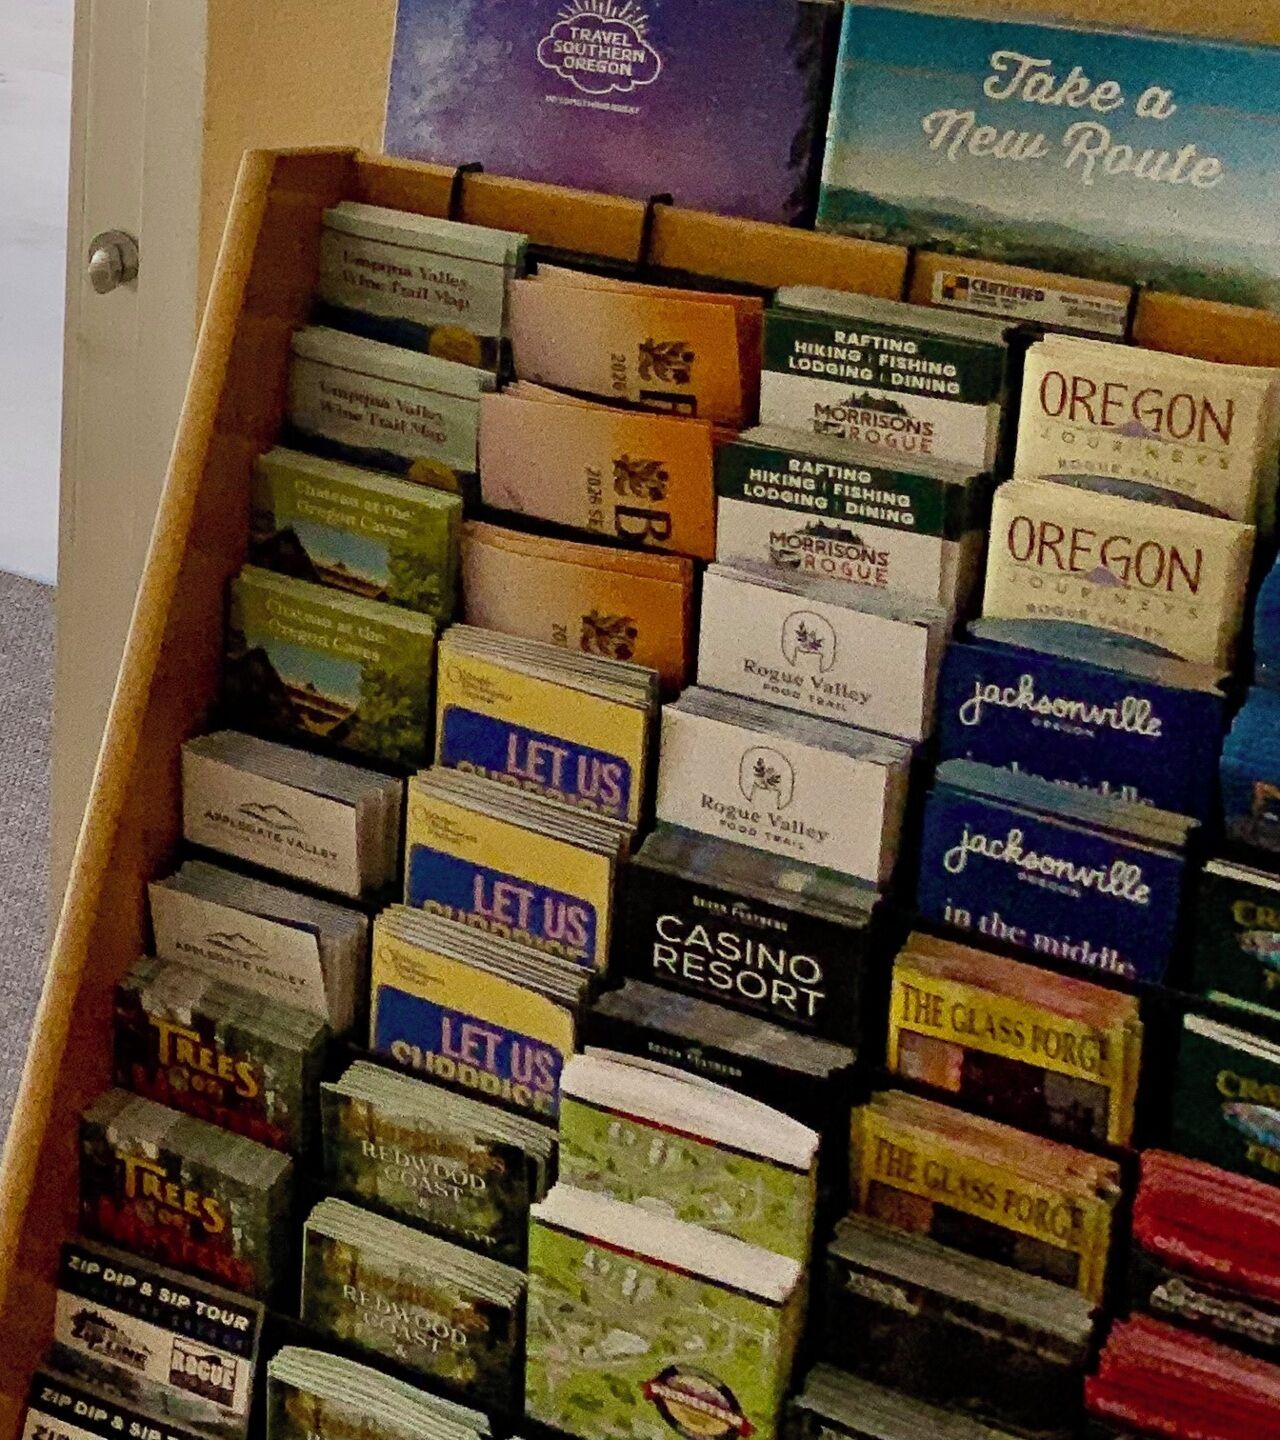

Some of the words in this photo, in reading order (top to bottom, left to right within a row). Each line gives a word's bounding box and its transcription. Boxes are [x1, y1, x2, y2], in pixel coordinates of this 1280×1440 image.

[553, 40, 647, 64] SOUTHERN
[569, 26, 632, 48] TRAVEL
[563, 56, 632, 77] OREGON
[983, 50, 1125, 112] Take
[1136, 86, 1177, 120] a
[922, 108, 1051, 163] New
[1062, 120, 1226, 189] Route
[794, 340, 864, 363] HIKING
[878, 353, 957, 377] FISHING
[834, 330, 918, 355] RAFTING
[789, 355, 874, 381] LODGING
[891, 372, 961, 395] DINING
[813, 402, 935, 437] MORRISONS
[1039, 370, 1235, 446] OREGON
[848, 427, 934, 455] ROGUE
[749, 468, 817, 491] HIKING
[833, 482, 911, 508] FISHING
[788, 458, 872, 484] RAFTING
[743, 483, 829, 510] LODGING
[845, 501, 916, 525] DINING
[768, 530, 890, 567] MORRISONS
[804, 554, 890, 585] ROGUE
[1007, 515, 1203, 596] OREGON
[744, 658, 805, 688] Rogue
[811, 675, 872, 705] Valley
[762, 682, 802, 700] FOOD
[809, 694, 849, 712] TRAIL
[959, 672, 1163, 739] jacksonville
[507, 731, 570, 788] LET
[577, 754, 623, 800] US
[701, 792, 763, 824] Rogue
[767, 812, 831, 844] Valley
[718, 819, 758, 839] FOOD
[764, 831, 806, 851] TRAIL
[286, 836, 338, 860] VALLEY
[943, 822, 1151, 906] jacksonville
[473, 873, 535, 931] LET
[544, 895, 590, 947] US
[944, 897, 971, 928] in
[978, 912, 1027, 944] the
[655, 914, 824, 985] CASINO
[255, 964, 307, 986] VALLEY
[652, 942, 826, 1017] RESORT
[901, 981, 944, 1030] THE
[950, 1000, 1024, 1051] GLASS
[1029, 1024, 1109, 1077] FORGE
[148, 1015, 260, 1099] TREES
[441, 1016, 504, 1073] LET
[511, 1040, 556, 1093] US
[361, 1138, 488, 1191] REDWOOD
[383, 1163, 465, 1202] COAST
[113, 1147, 226, 1234] TREES
[872, 1147, 917, 1184] THE
[921, 1162, 997, 1211] GLASS
[1002, 1188, 1086, 1247] FORGE
[67, 1255, 101, 1276] ZIP
[102, 1267, 137, 1288] DIP
[139, 1281, 154, 1297] &
[158, 1287, 191, 1309] SIP
[195, 1300, 251, 1332] TOUR
[342, 1283, 467, 1348] REDWOOD
[40, 1387, 73, 1407] ZIP
[73, 1400, 109, 1422] DIP
[110, 1415, 125, 1432] &
